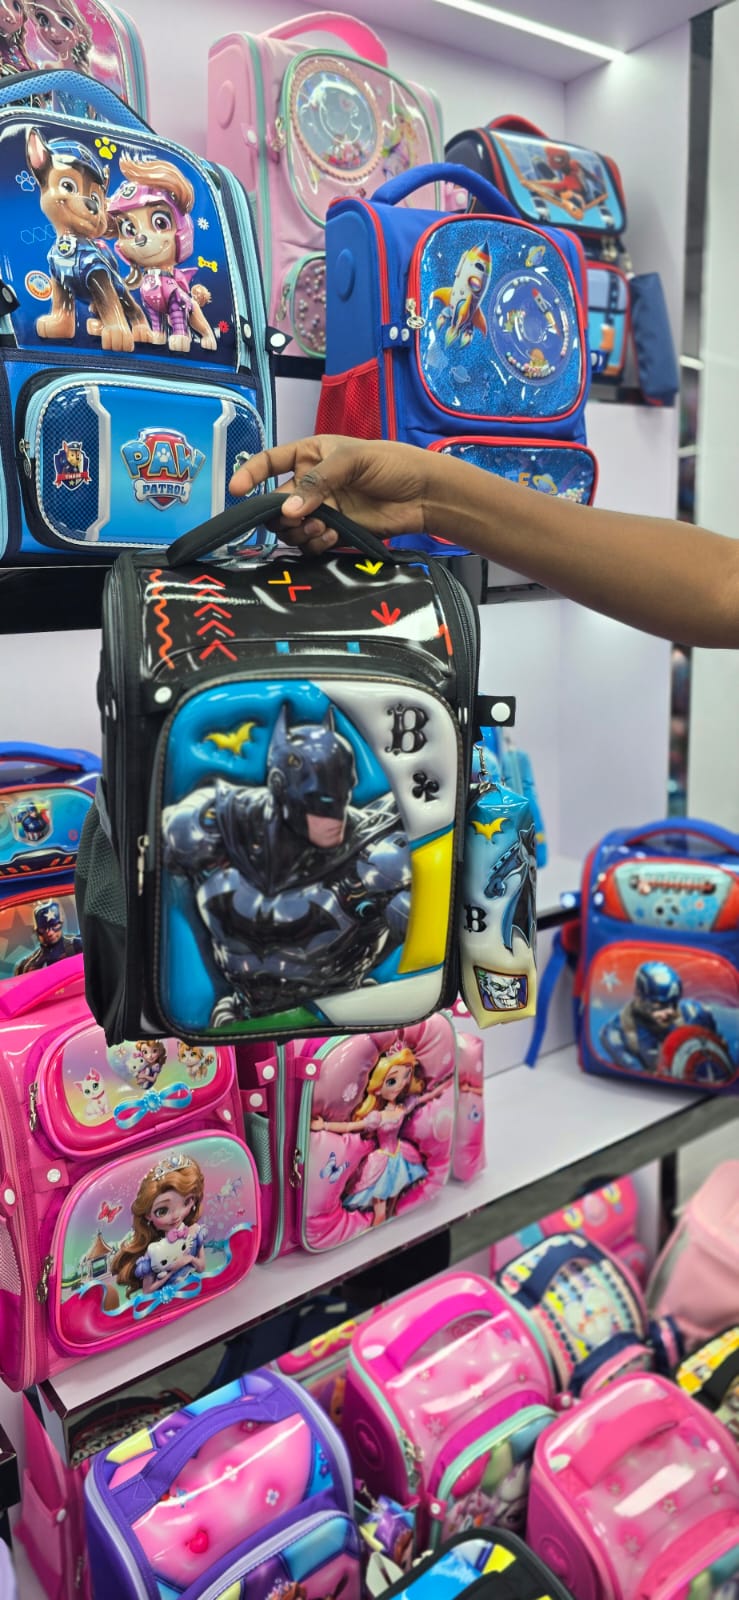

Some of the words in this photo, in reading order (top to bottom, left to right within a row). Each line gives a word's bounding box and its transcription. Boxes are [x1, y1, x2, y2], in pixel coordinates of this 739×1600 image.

[121, 440, 206, 480] PAW
[142, 483, 186, 496] PATROL
[385, 703, 429, 756] B
[464, 904, 488, 933] B
